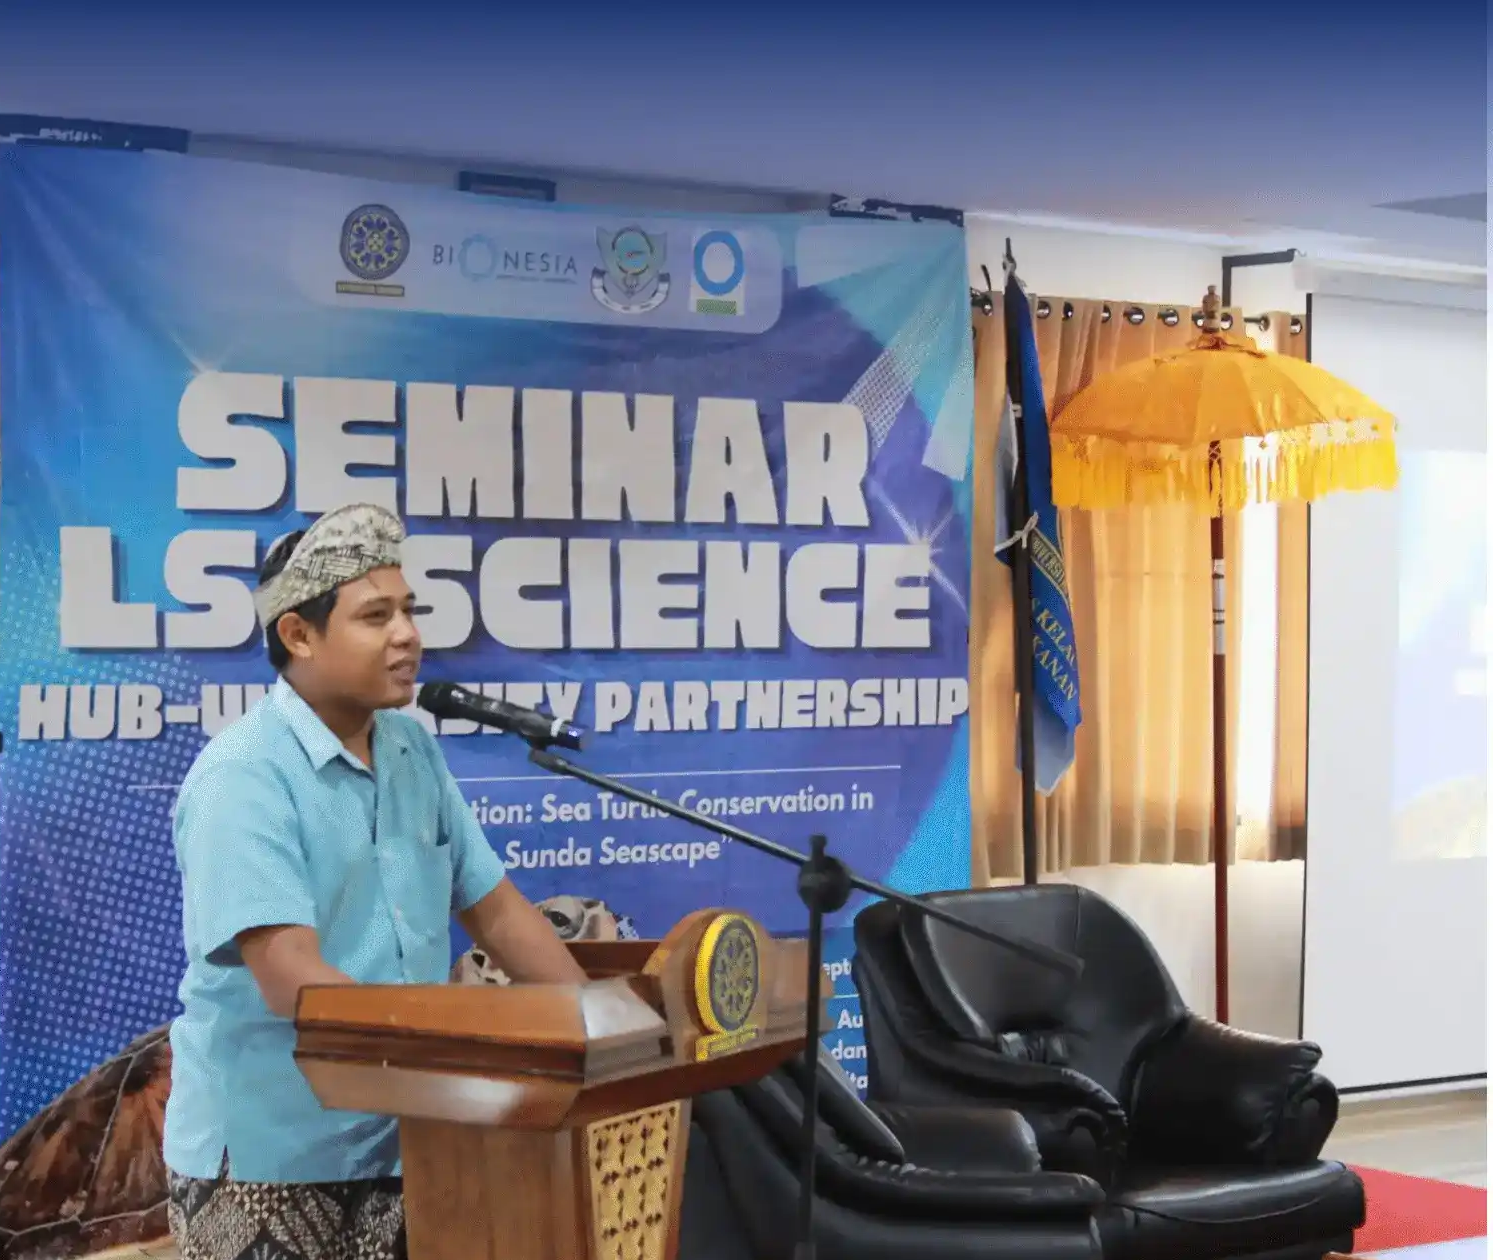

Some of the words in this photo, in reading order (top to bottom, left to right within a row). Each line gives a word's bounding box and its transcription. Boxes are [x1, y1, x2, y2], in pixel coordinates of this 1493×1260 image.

[175, 373, 871, 528] SEMINAR
[408, 535, 933, 650] SCIENCE
[595, 678, 967, 732] PARTNERSHIP
[541, 793, 591, 823] Sea
[677, 785, 844, 815] Conservation
[851, 785, 873, 810] in
[503, 840, 591, 870] Sunda
